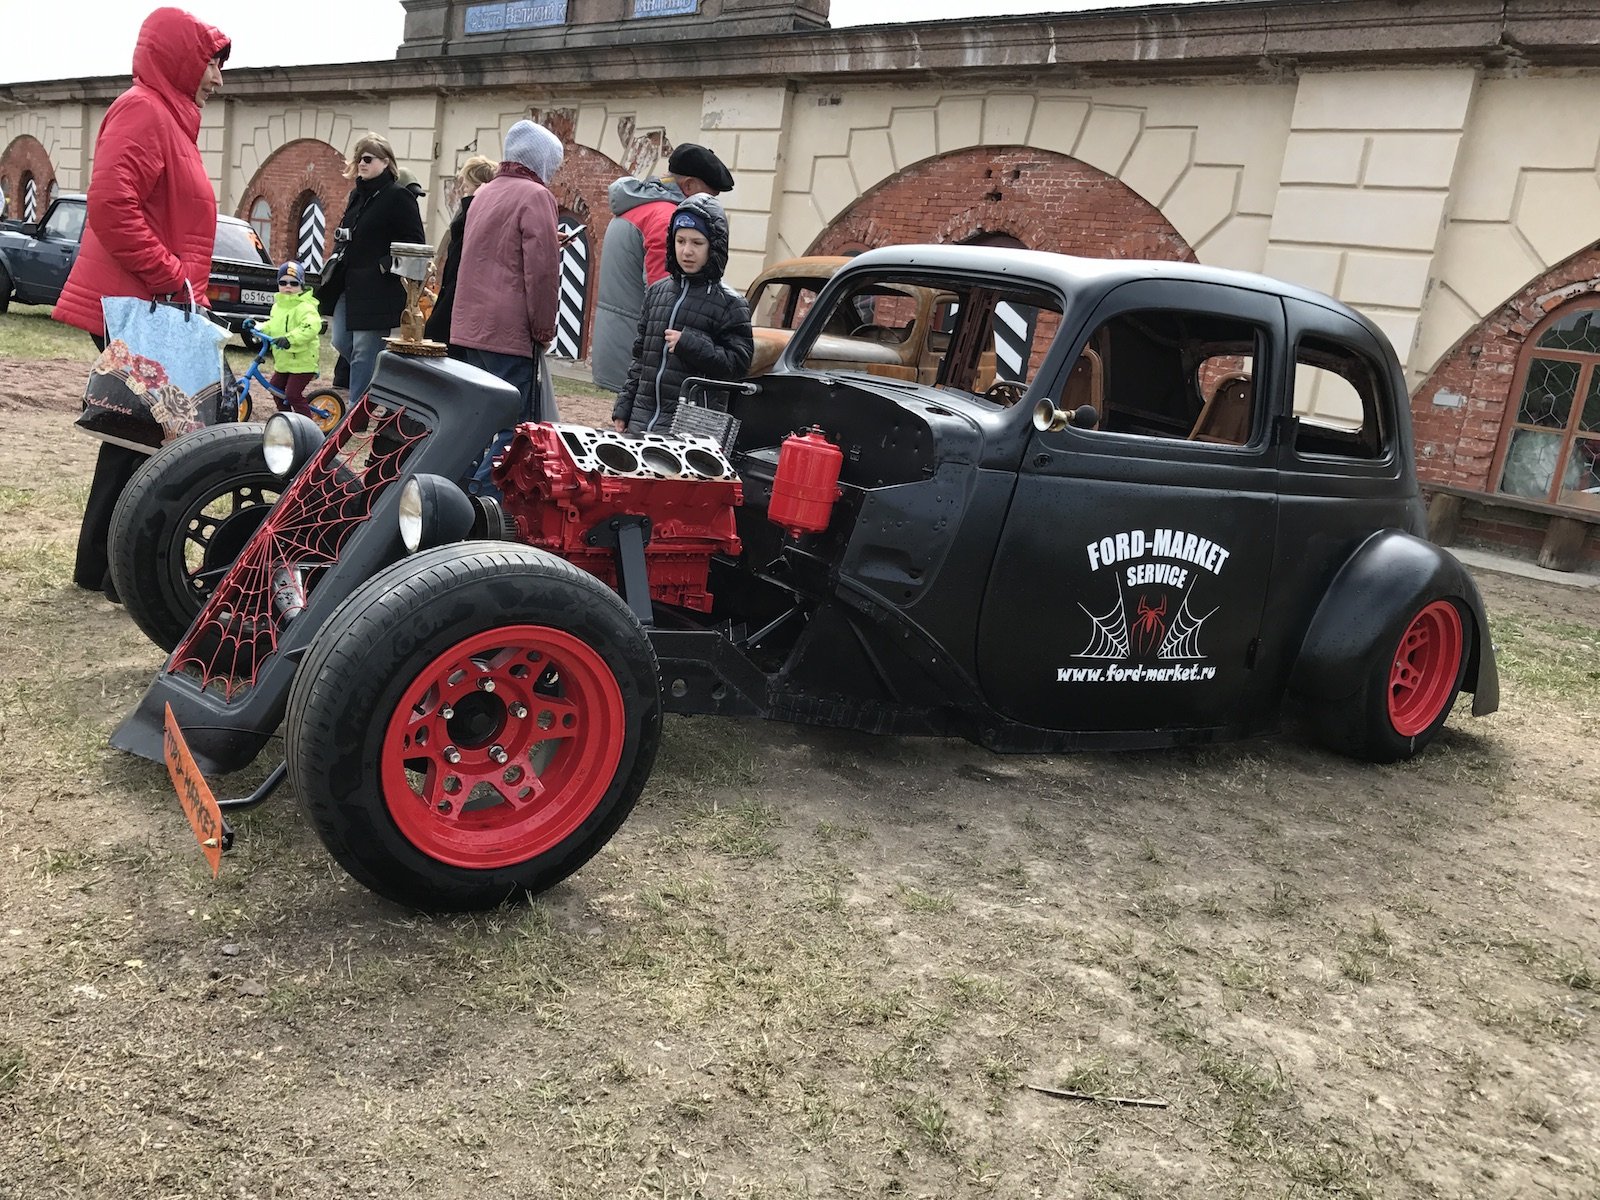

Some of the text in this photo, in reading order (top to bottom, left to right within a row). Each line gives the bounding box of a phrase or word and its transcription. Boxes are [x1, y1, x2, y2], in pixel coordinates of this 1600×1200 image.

[1086, 528, 1231, 576] FORD-MARKET
[1126, 563, 1189, 588] SERVICE
[1056, 662, 1217, 683] www.ford-market.ru
